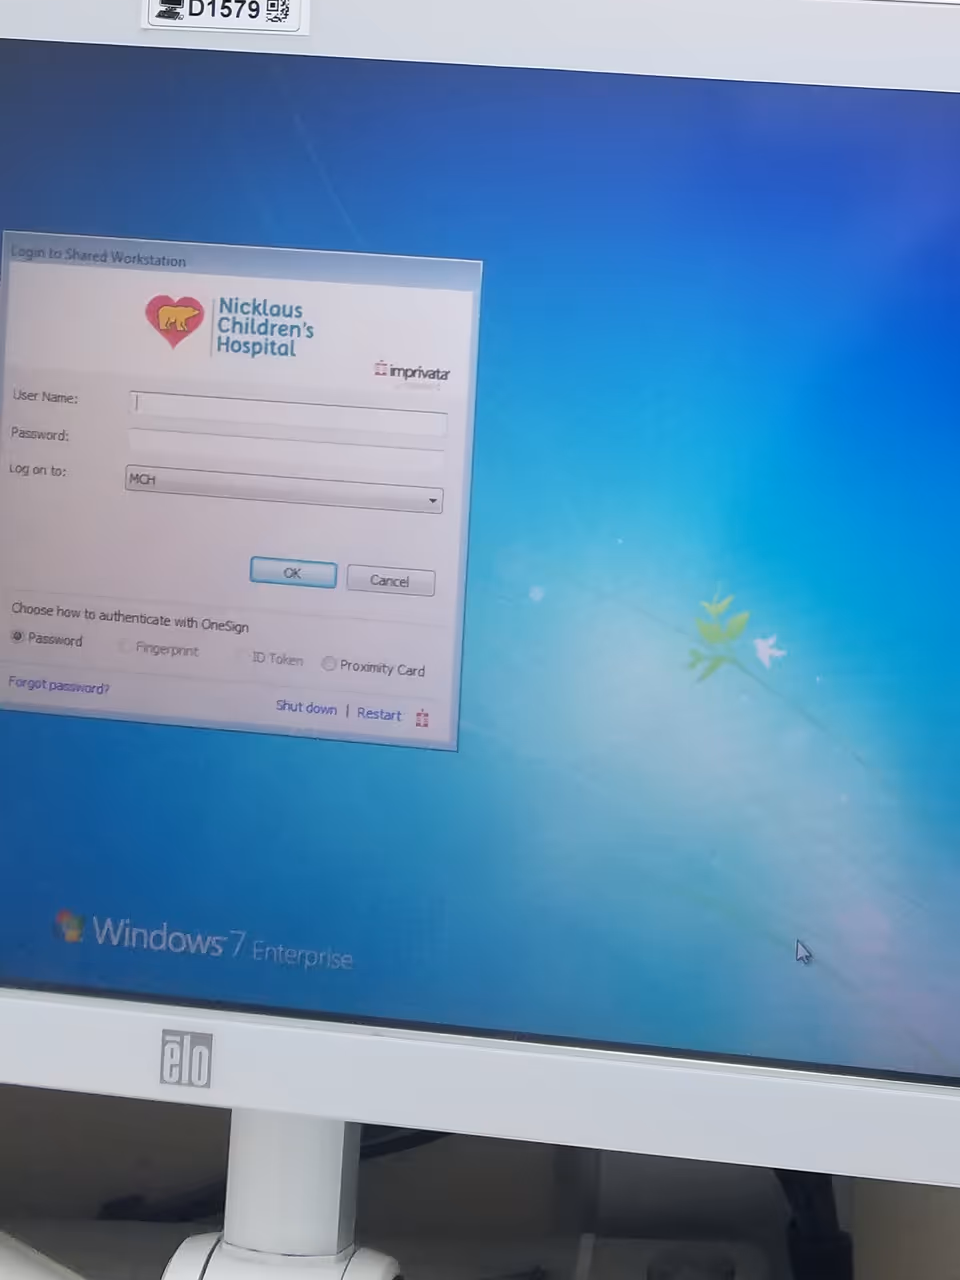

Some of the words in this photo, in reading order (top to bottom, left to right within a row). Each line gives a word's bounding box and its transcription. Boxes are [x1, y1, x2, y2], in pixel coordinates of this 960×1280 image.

[11, 245, 45, 260] Login
[50, 247, 61, 259] to
[65, 248, 107, 263] Shared
[111, 250, 187, 268] Workstation
[219, 297, 303, 318] Nicklaus
[217, 316, 314, 339] Children's
[217, 336, 296, 358] Hospital
[13, 388, 38, 401] User
[42, 391, 78, 404] Name:
[11, 426, 69, 442] Password:
[9, 464, 30, 477] Log
[32, 466, 47, 475] on
[51, 465, 66, 477] to:
[129, 473, 156, 485] MCH
[283, 567, 302, 579] OK
[370, 574, 410, 588] Cancel
[11, 602, 53, 617] Choose
[56, 604, 81, 619] how
[84, 608, 96, 620] to
[99, 610, 171, 627] authenticate
[174, 616, 198, 629] with
[201, 619, 249, 635] OneSign
[28, 631, 83, 647] Password
[136, 641, 200, 657] Fingerprint
[253, 651, 265, 663] ID
[269, 652, 304, 666] Token
[340, 659, 393, 676] Proximity
[397, 664, 426, 678] Card
[8, 676, 47, 691] Forgot
[49, 680, 110, 695] password?
[276, 699, 303, 713] Shut
[306, 701, 337, 715] down
[358, 707, 402, 721] Restart
[93, 915, 228, 957] Windows
[230, 929, 247, 958] 7
[253, 940, 353, 970] Enterprise
